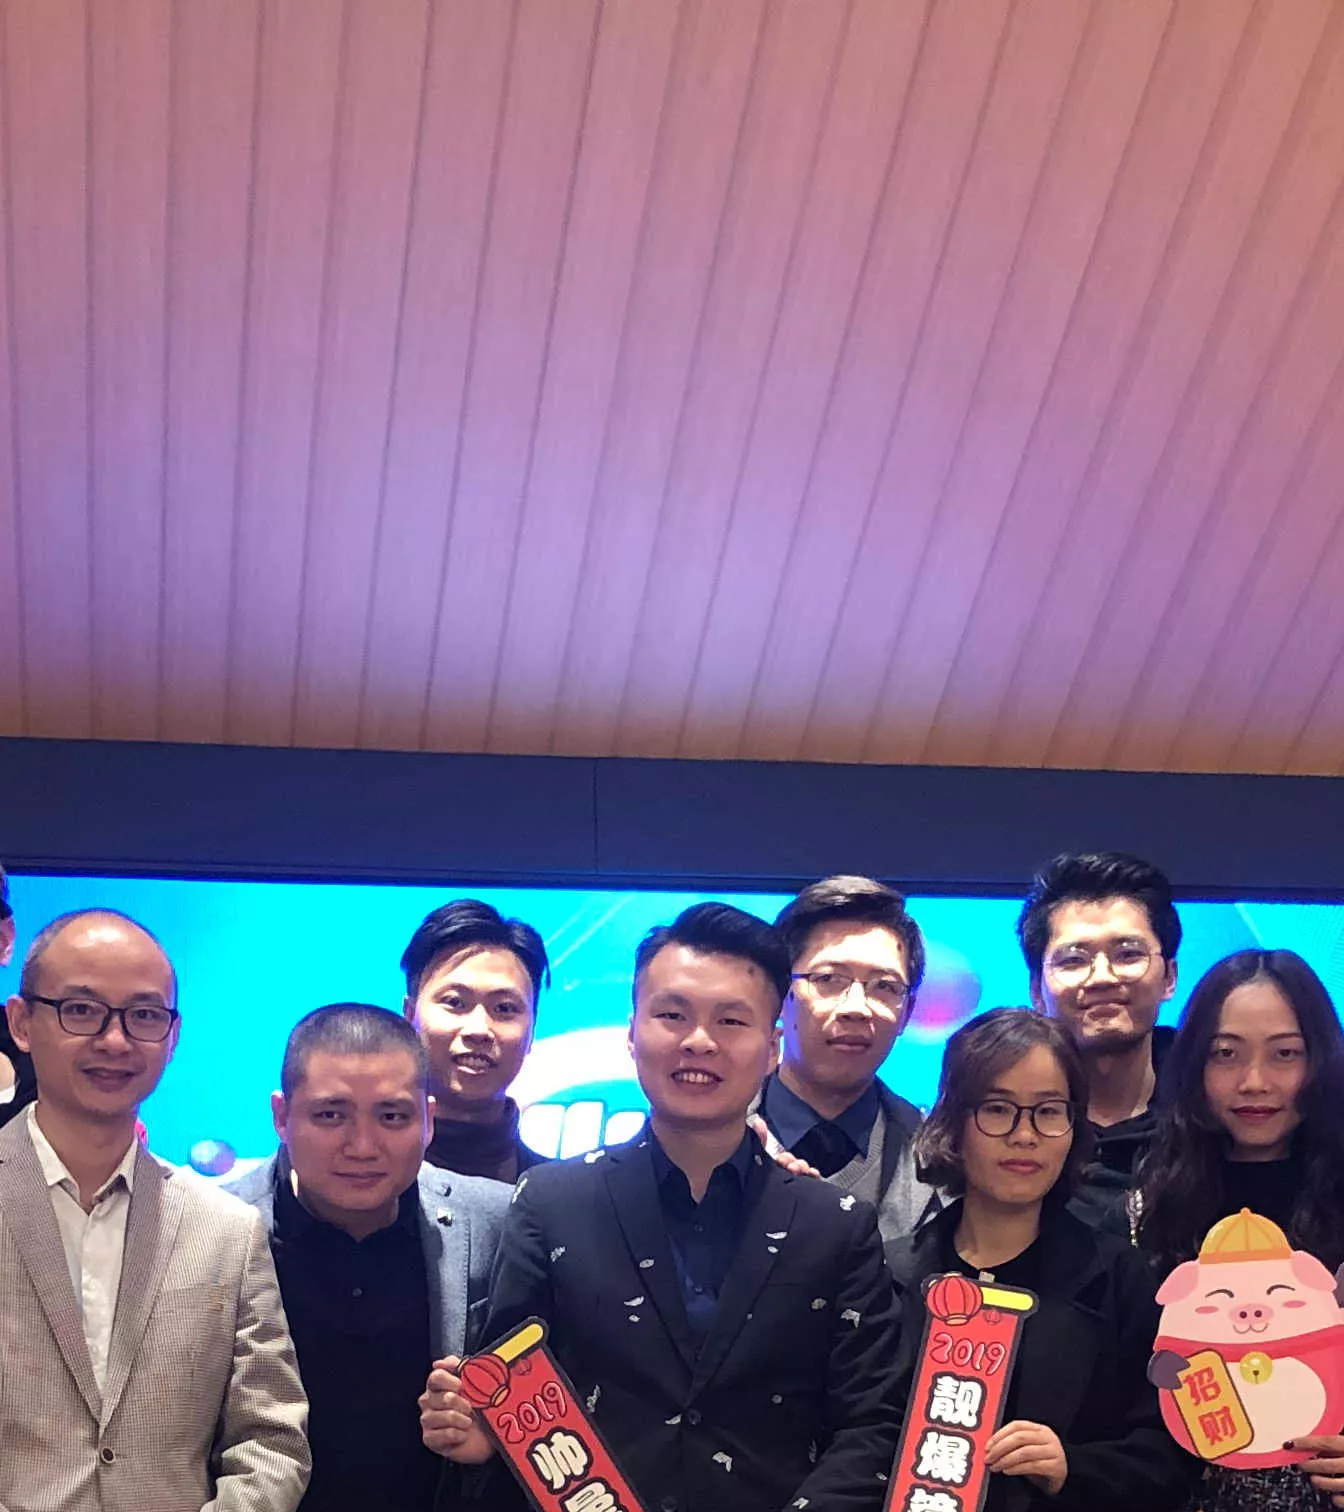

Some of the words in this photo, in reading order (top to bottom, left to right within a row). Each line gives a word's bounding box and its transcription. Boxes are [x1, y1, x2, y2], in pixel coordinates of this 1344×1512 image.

[929, 1332, 1006, 1376] 2019
[497, 1381, 568, 1444] 2019
[1183, 1366, 1238, 1446] 招财
